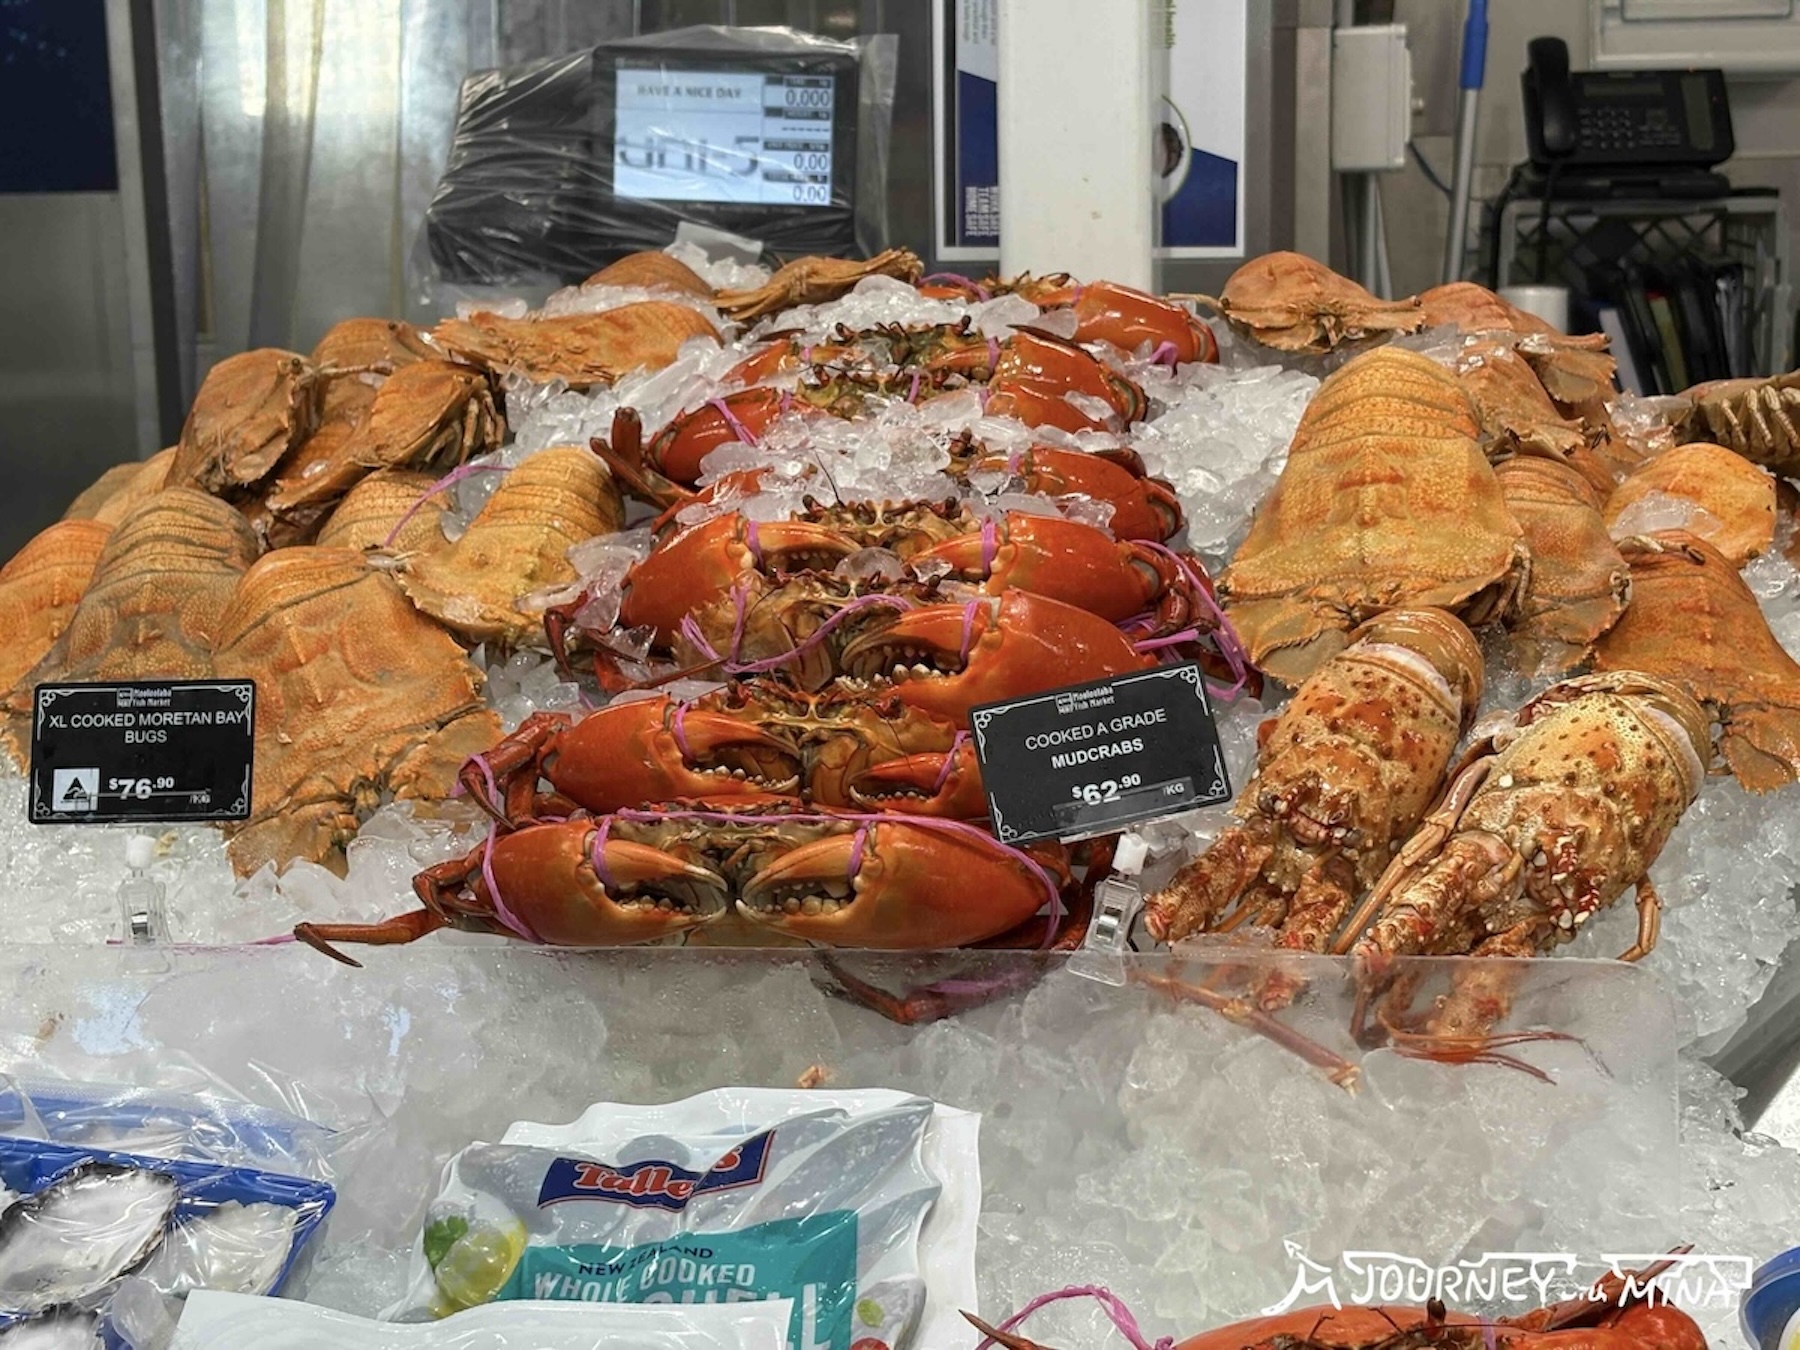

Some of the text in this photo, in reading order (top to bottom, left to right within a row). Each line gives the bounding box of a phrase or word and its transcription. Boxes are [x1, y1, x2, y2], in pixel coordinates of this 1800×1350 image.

[637, 85, 742, 98] HAVE A NICE DAY
[785, 89, 830, 107] 0.000
[793, 153, 828, 171] 0.00
[792, 185, 827, 202] 0.00
[965, 187, 977, 236] HOME SAFE
[978, 187, 990, 236] TEAM SAFE
[49, 710, 244, 728] XL COOKED MORETAN BAY
[1025, 708, 1168, 750] COOKED A GRADE
[125, 730, 168, 744] BUGS
[1051, 737, 1145, 769] MUDCRABS
[578, 1242, 714, 1277] NEW ZEALAND
[639, 1256, 756, 1291] COOKED
